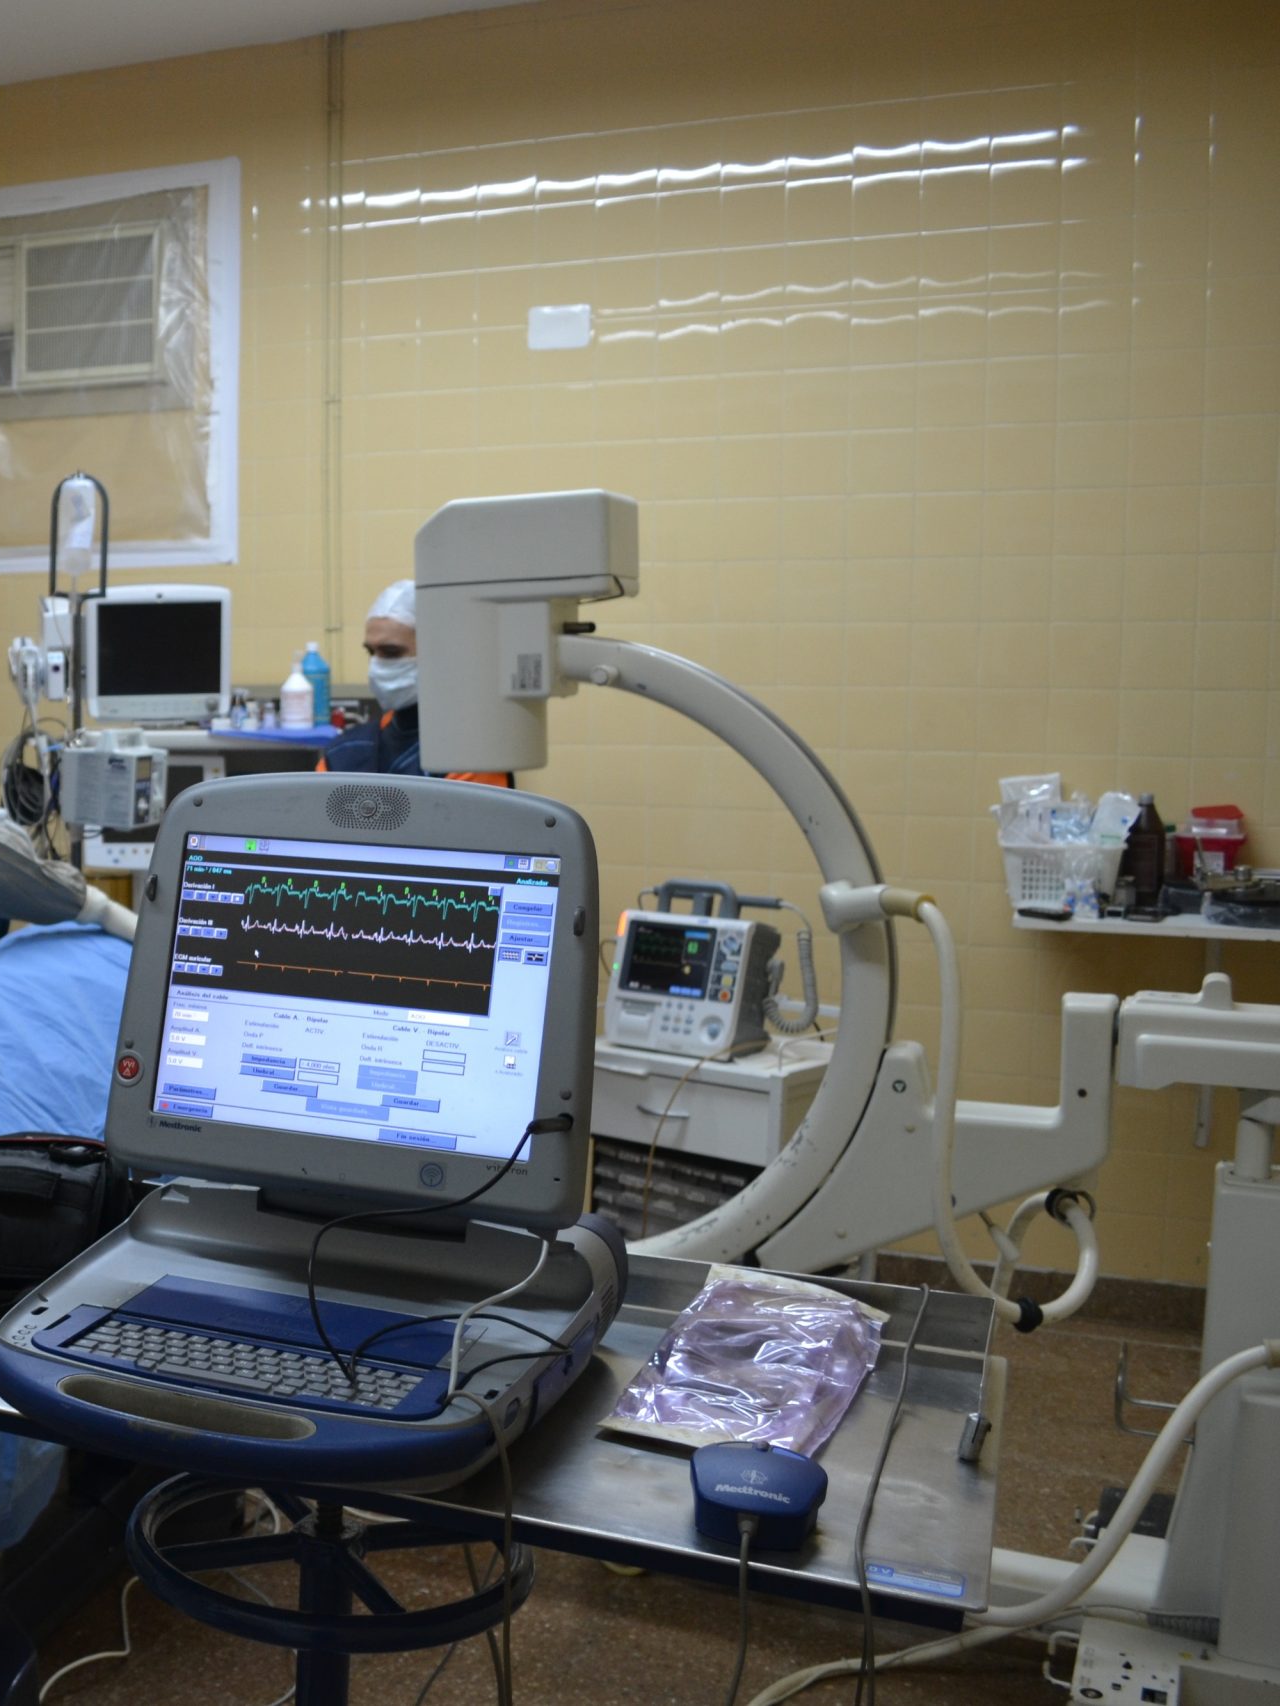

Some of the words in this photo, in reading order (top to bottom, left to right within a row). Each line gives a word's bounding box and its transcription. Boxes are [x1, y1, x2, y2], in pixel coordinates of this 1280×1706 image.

[516, 878, 548, 886] Analizador
[392, 1024, 410, 1032] Cable
[427, 1028, 450, 1037] Bipolar
[251, 1055, 285, 1064] Impedancia
[159, 1120, 202, 1132] Medtronic
[714, 1483, 791, 1504] Medtronic
